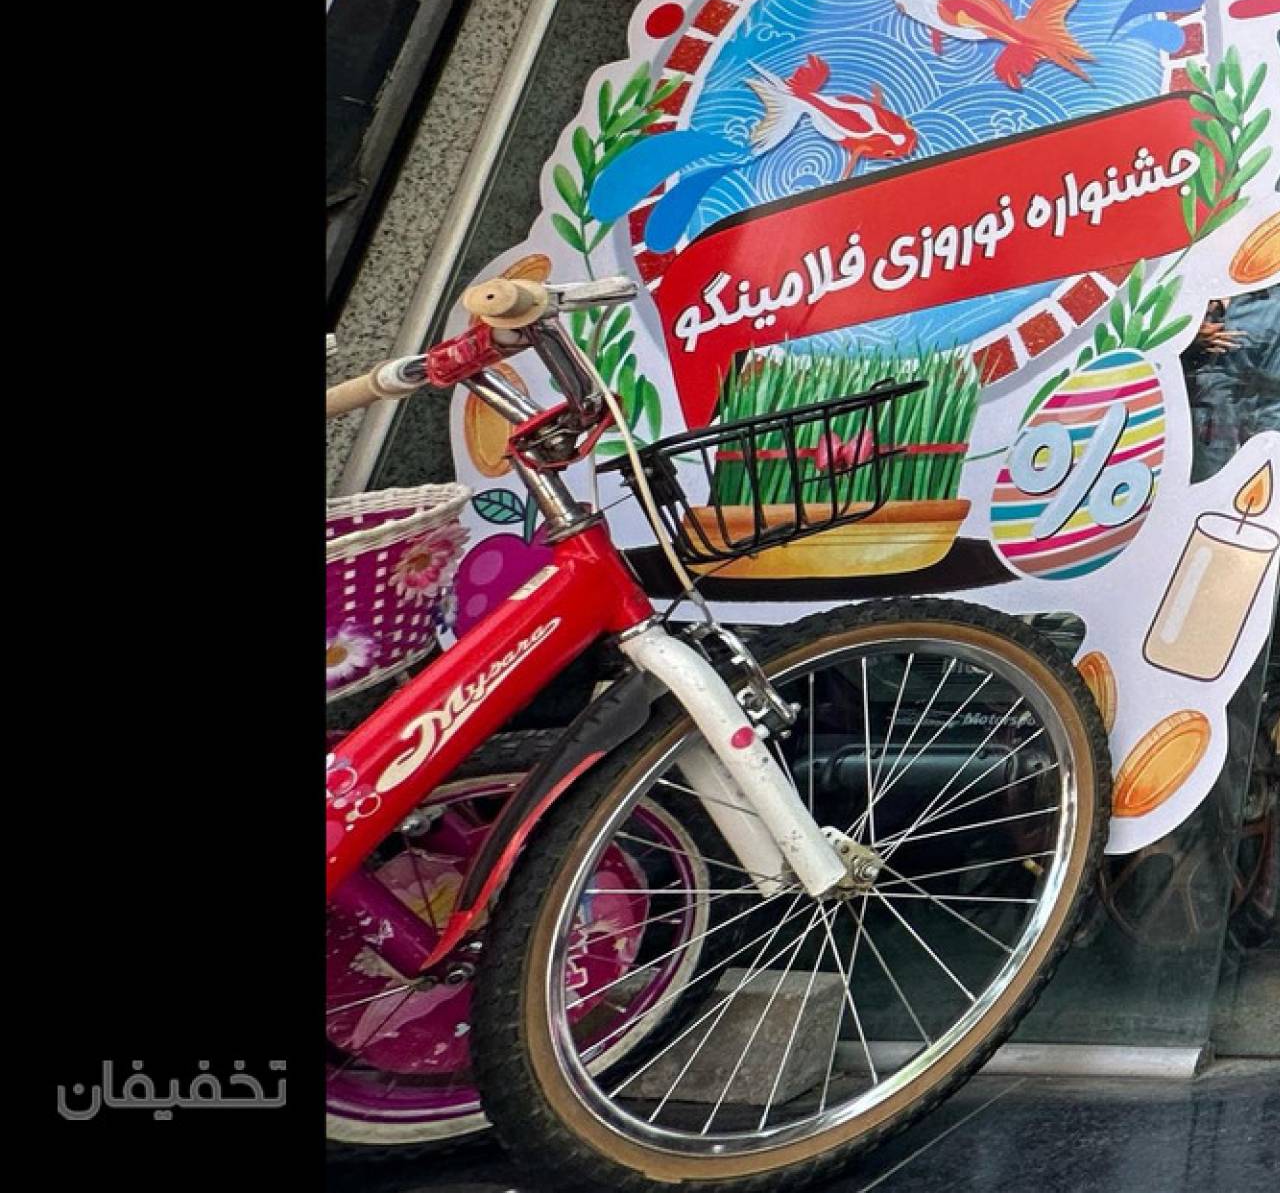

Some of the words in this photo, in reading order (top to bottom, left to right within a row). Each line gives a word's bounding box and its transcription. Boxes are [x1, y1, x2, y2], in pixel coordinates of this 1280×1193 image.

[1024, 146, 1202, 238] جشنواره
[869, 195, 1012, 292] نوروزی
[672, 234, 868, 354] فلامینگو
